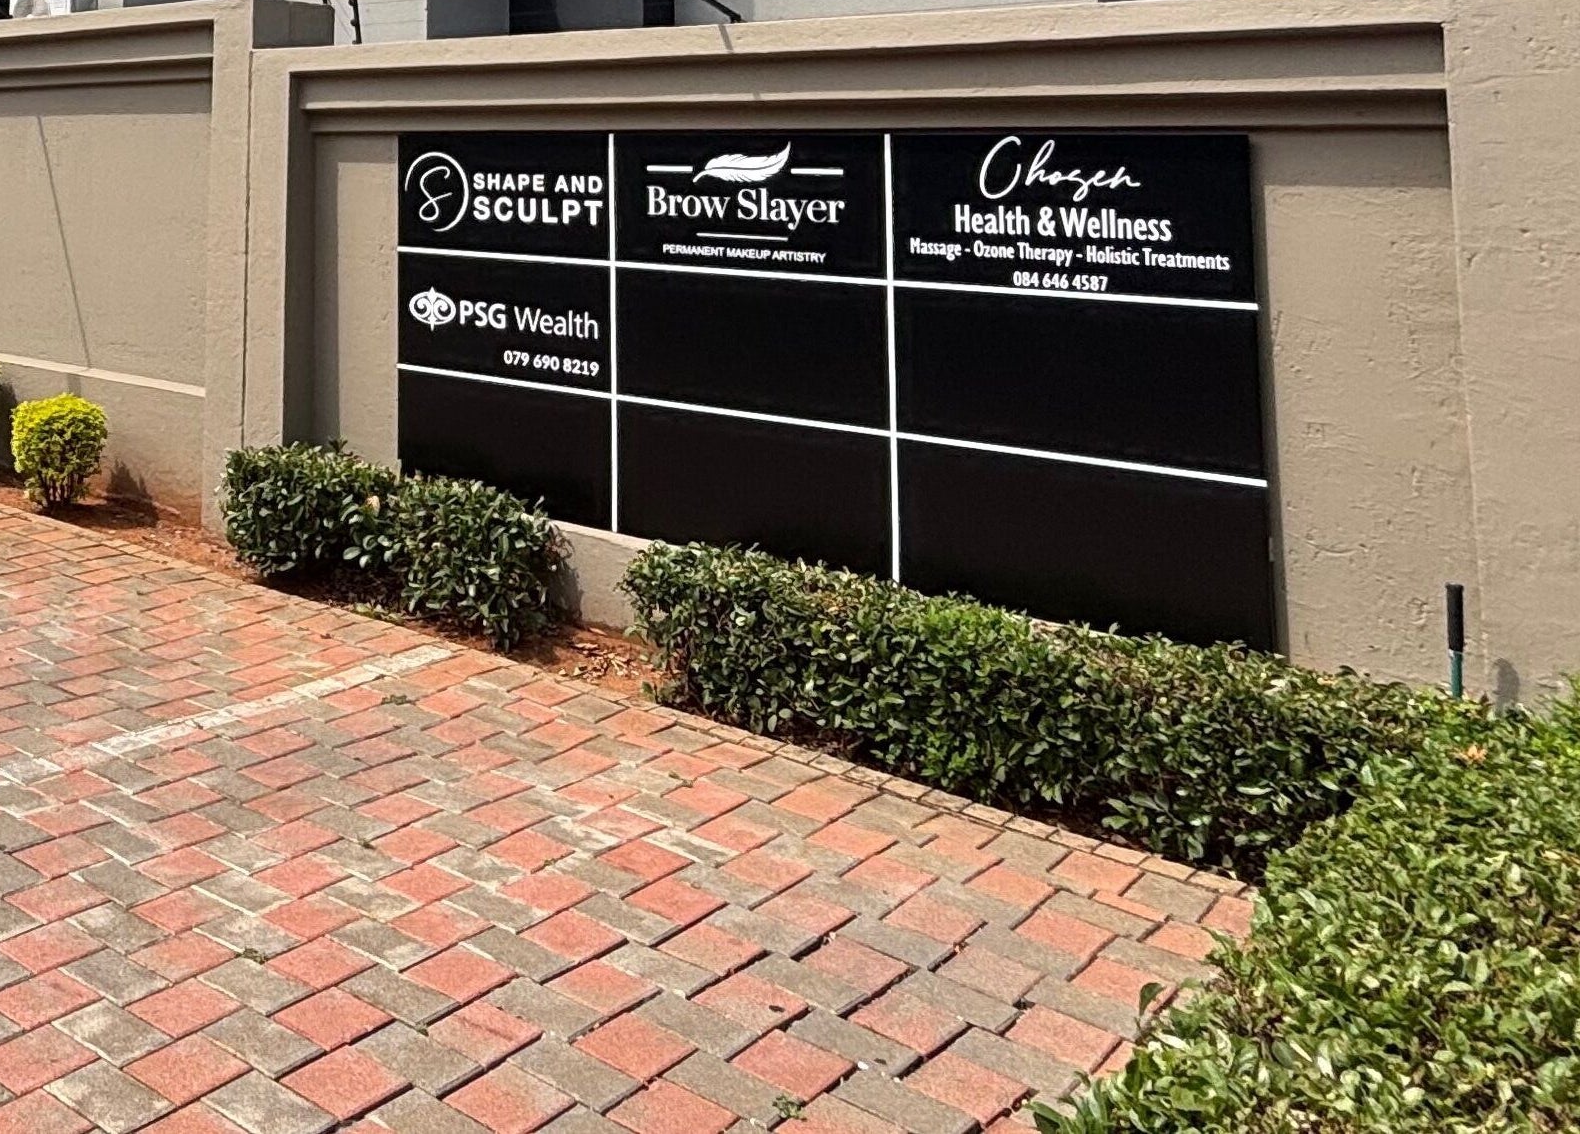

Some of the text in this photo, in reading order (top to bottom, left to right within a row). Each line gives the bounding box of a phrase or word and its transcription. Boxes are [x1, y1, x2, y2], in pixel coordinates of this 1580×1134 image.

[473, 172, 603, 194] SHAPE AND
[473, 195, 603, 226] SCULPT
[646, 185, 845, 231] Brow Slayer
[954, 204, 1172, 242] Health & Wellness
[663, 243, 827, 263] PERMANENT MAKEUP ARTISTRY
[909, 237, 962, 261] Massage
[973, 240, 1015, 259] Ozone
[1017, 242, 1073, 267] Therapy
[1086, 245, 1140, 265] Holistic
[1142, 247, 1231, 271] Treatments
[1012, 271, 1109, 292] 084 646 4587
[459, 300, 599, 339] PSG Wealth
[503, 350, 600, 377] 079 690 8219
